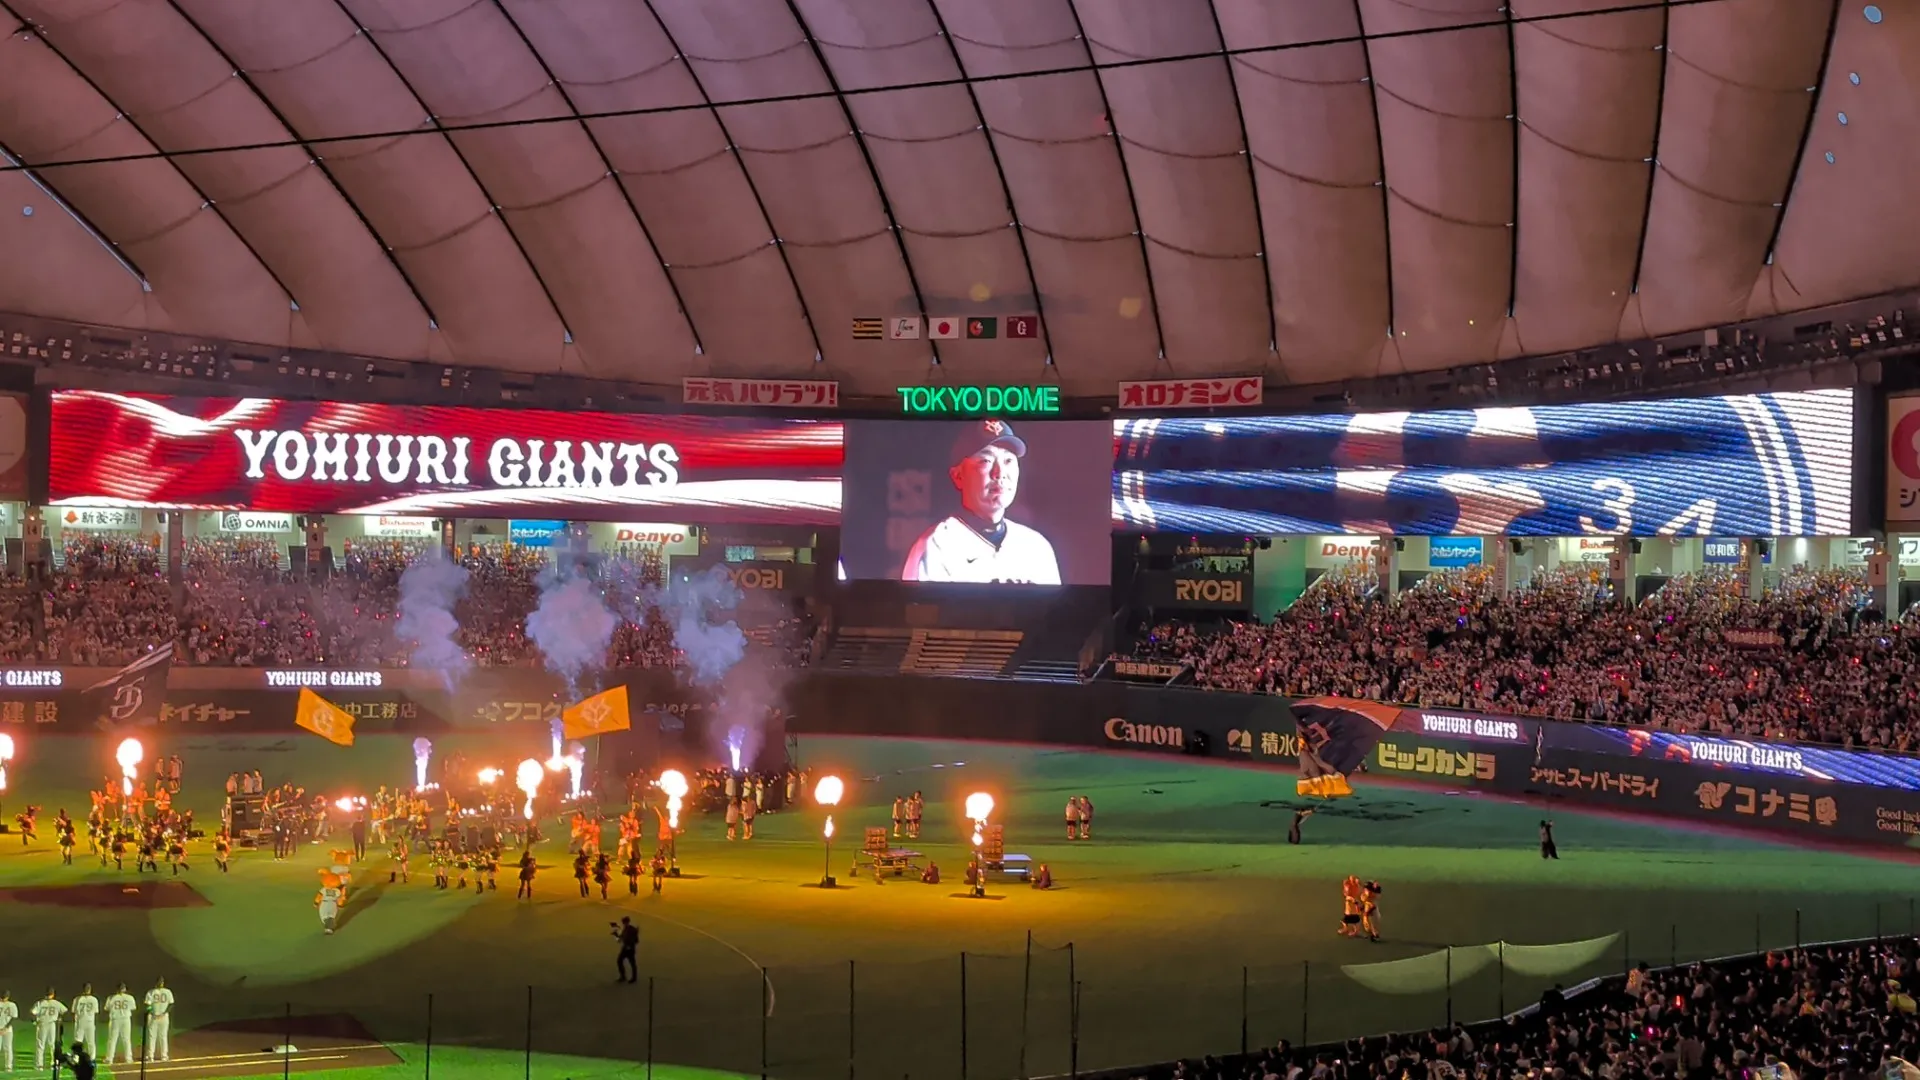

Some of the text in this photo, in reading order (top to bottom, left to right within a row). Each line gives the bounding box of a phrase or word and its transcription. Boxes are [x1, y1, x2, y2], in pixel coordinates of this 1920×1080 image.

[898, 387, 1059, 411] TOKYO DOME
[1124, 379, 1258, 406] オロナミンC
[234, 429, 680, 488] YOMIURI GIANTS
[245, 519, 290, 529] OMNIA
[616, 529, 684, 545] Denyo
[727, 569, 783, 589] YOBI
[1175, 579, 1242, 602] RYOBI
[6, 671, 62, 686] GIANTS
[266, 671, 382, 686] YOMIURI GIANTS
[344, 702, 417, 719] 中工務店
[503, 702, 564, 721] フコク
[1104, 717, 1183, 747] Canon
[1422, 713, 1518, 739] YOMIURI GIANTS
[1261, 731, 1300, 756] 積水
[1379, 742, 1496, 780] ビックカメラ
[1690, 742, 1802, 770] YOMIURI GIANTS
[1530, 766, 1660, 797] アサヒスーパードライ
[1735, 786, 1811, 822] コナミ
